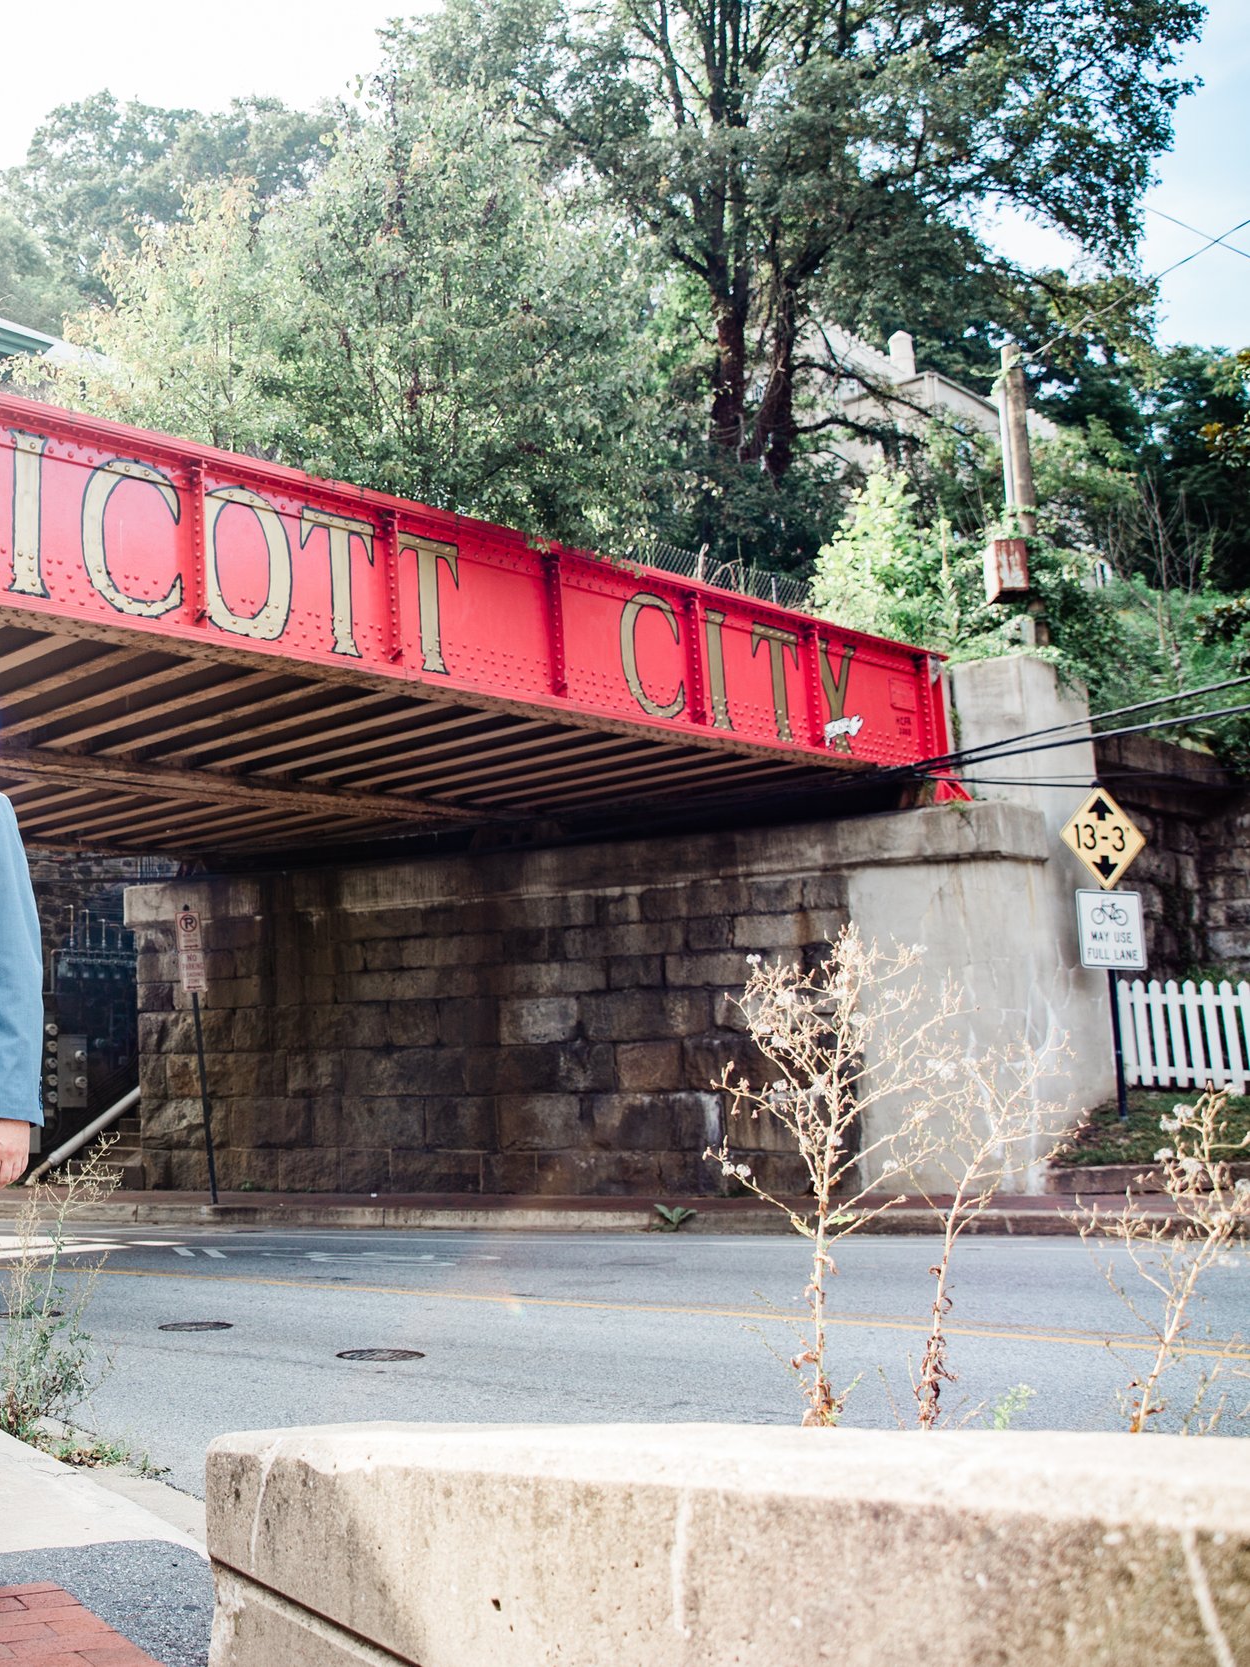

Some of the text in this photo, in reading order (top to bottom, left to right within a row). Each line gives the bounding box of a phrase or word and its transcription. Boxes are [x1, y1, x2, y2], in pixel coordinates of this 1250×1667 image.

[619, 591, 856, 754] CITY
[1090, 930, 1132, 943] MAY USE
[1086, 947, 1139, 961] FULL LANE
